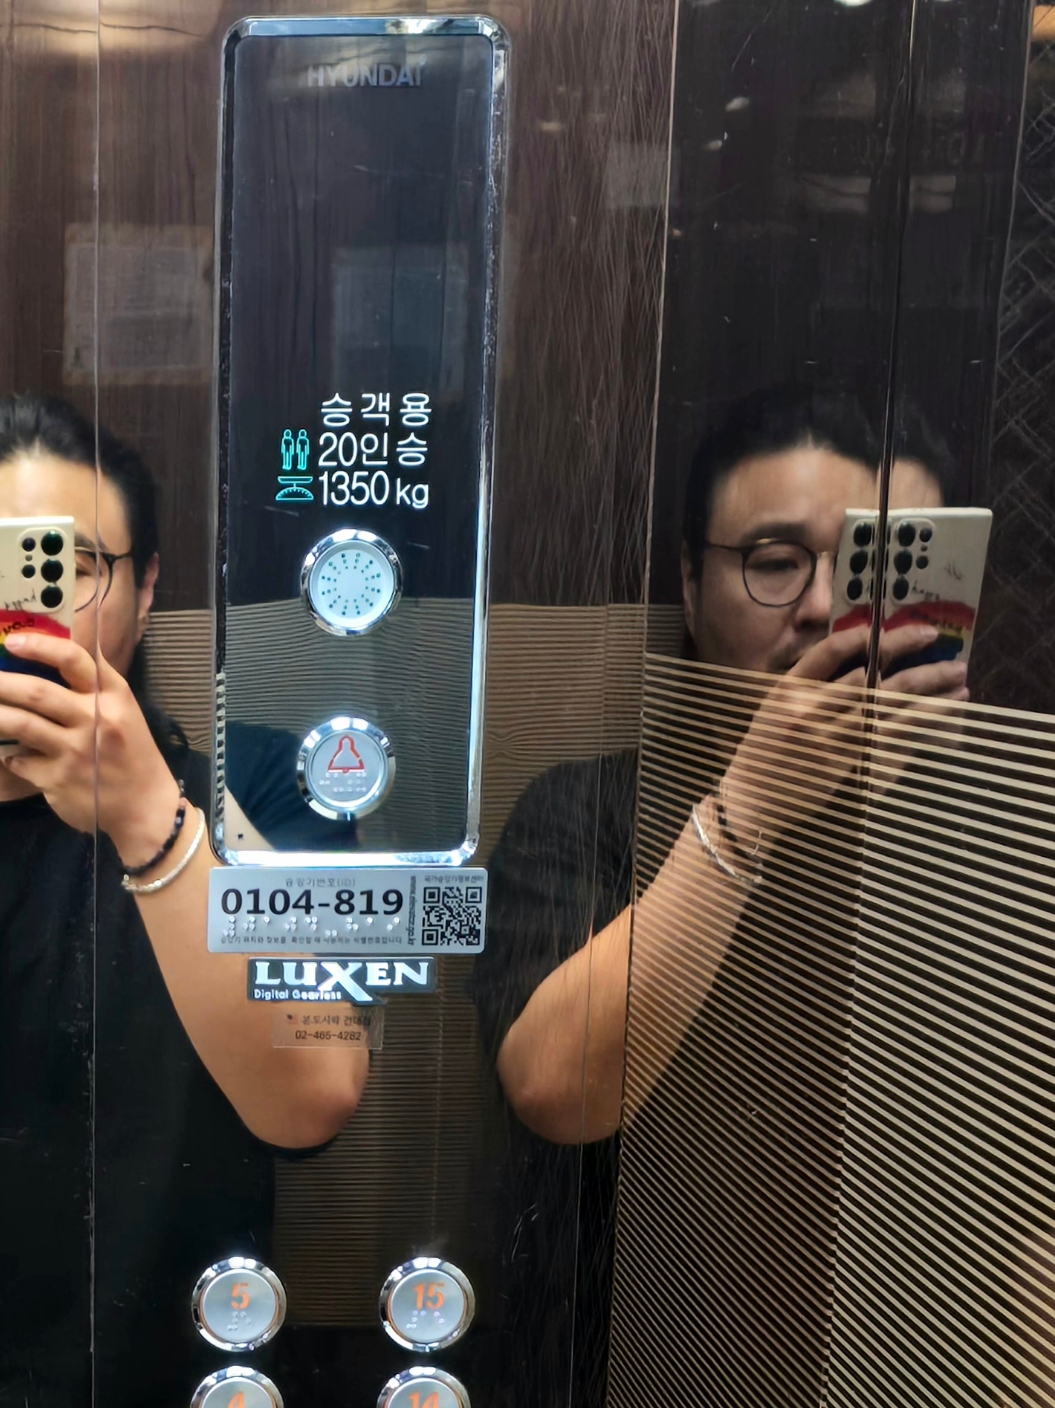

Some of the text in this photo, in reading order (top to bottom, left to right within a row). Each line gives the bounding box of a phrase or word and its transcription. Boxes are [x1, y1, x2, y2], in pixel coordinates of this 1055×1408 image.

[307, 63, 423, 87] HYUNDAI
[221, 888, 404, 916] 0104-819
[254, 989, 288, 1001] Digital
[255, 961, 429, 1001] LUXEN
[230, 1282, 250, 1310] 5
[413, 1282, 444, 1310] 15
